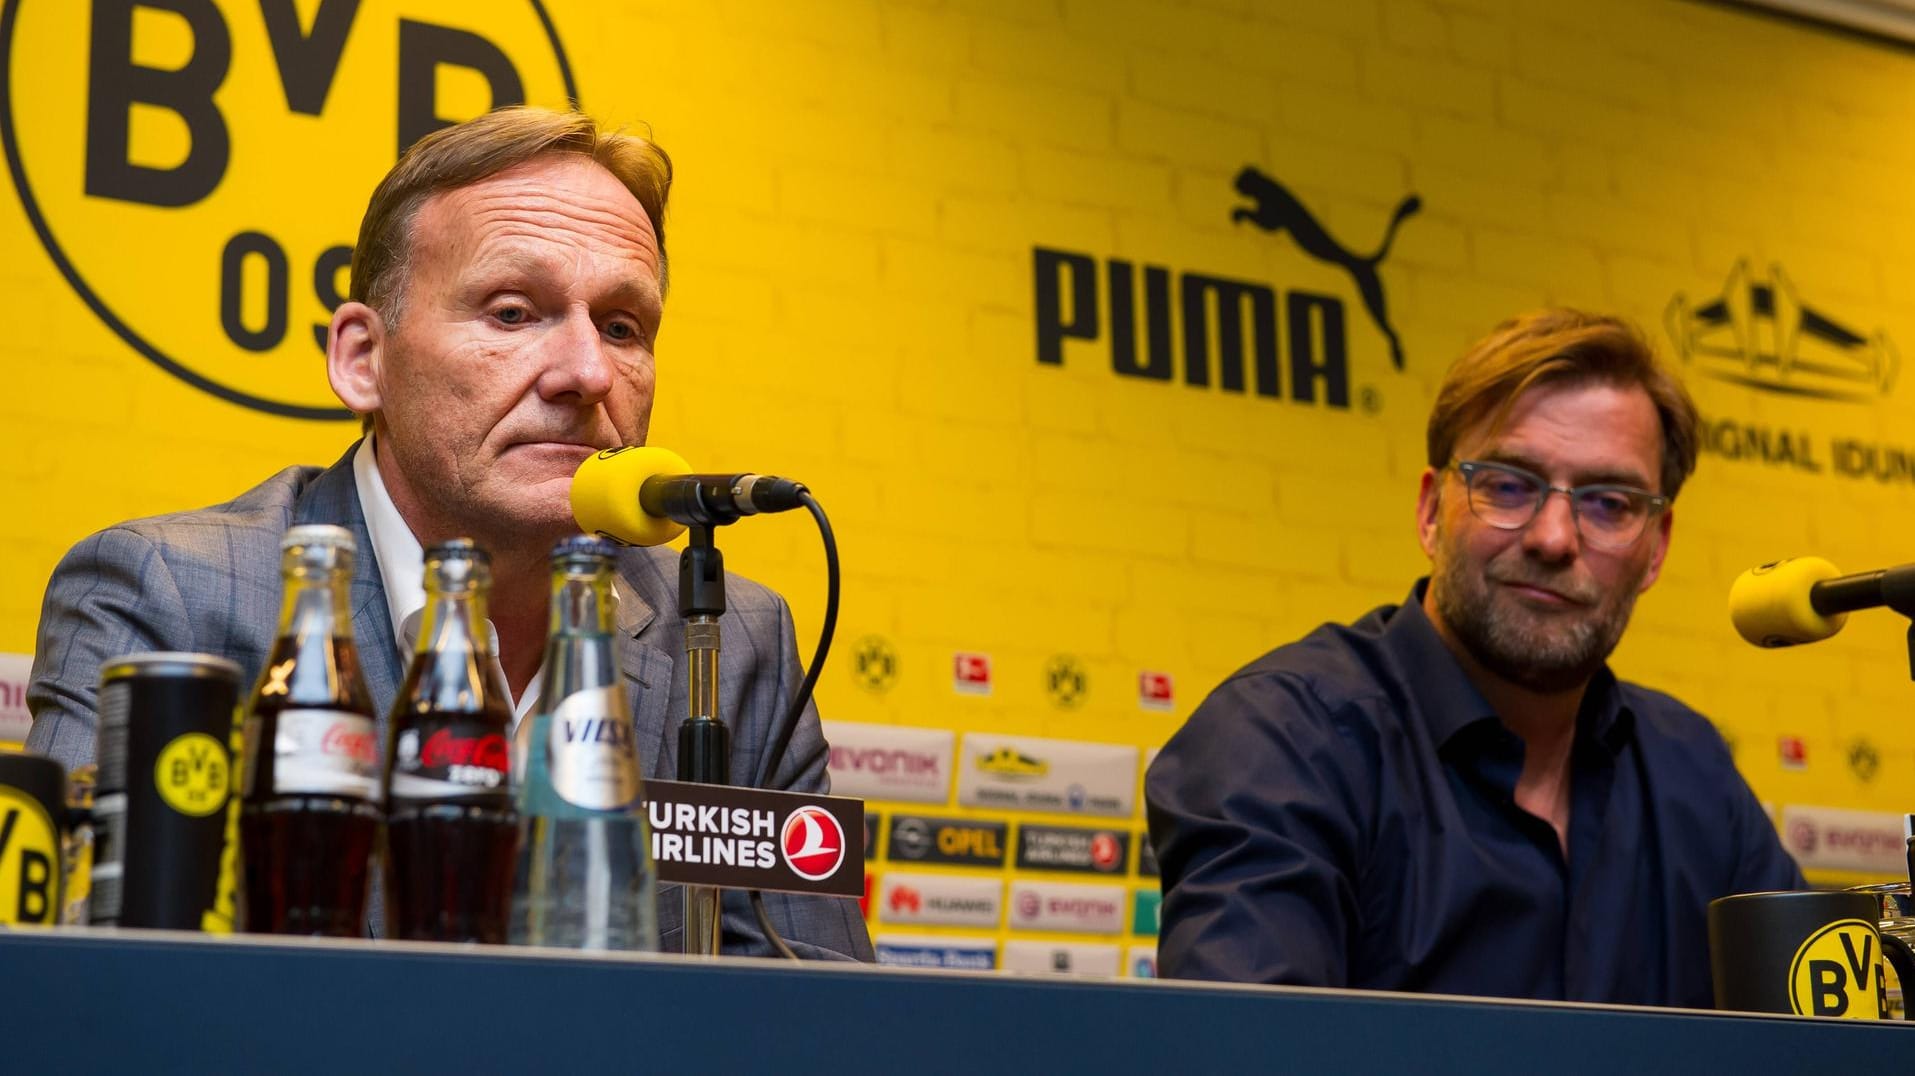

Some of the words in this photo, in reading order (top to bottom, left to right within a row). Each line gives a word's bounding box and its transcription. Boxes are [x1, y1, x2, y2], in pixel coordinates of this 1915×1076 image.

[1033, 247, 1349, 407] PUMA
[1699, 418, 1823, 474] IGNAL
[1832, 437, 1915, 486] IDUN
[643, 801, 775, 838] URKISH
[652, 832, 777, 869] IRLINES
[937, 826, 1000, 858] OPEL
